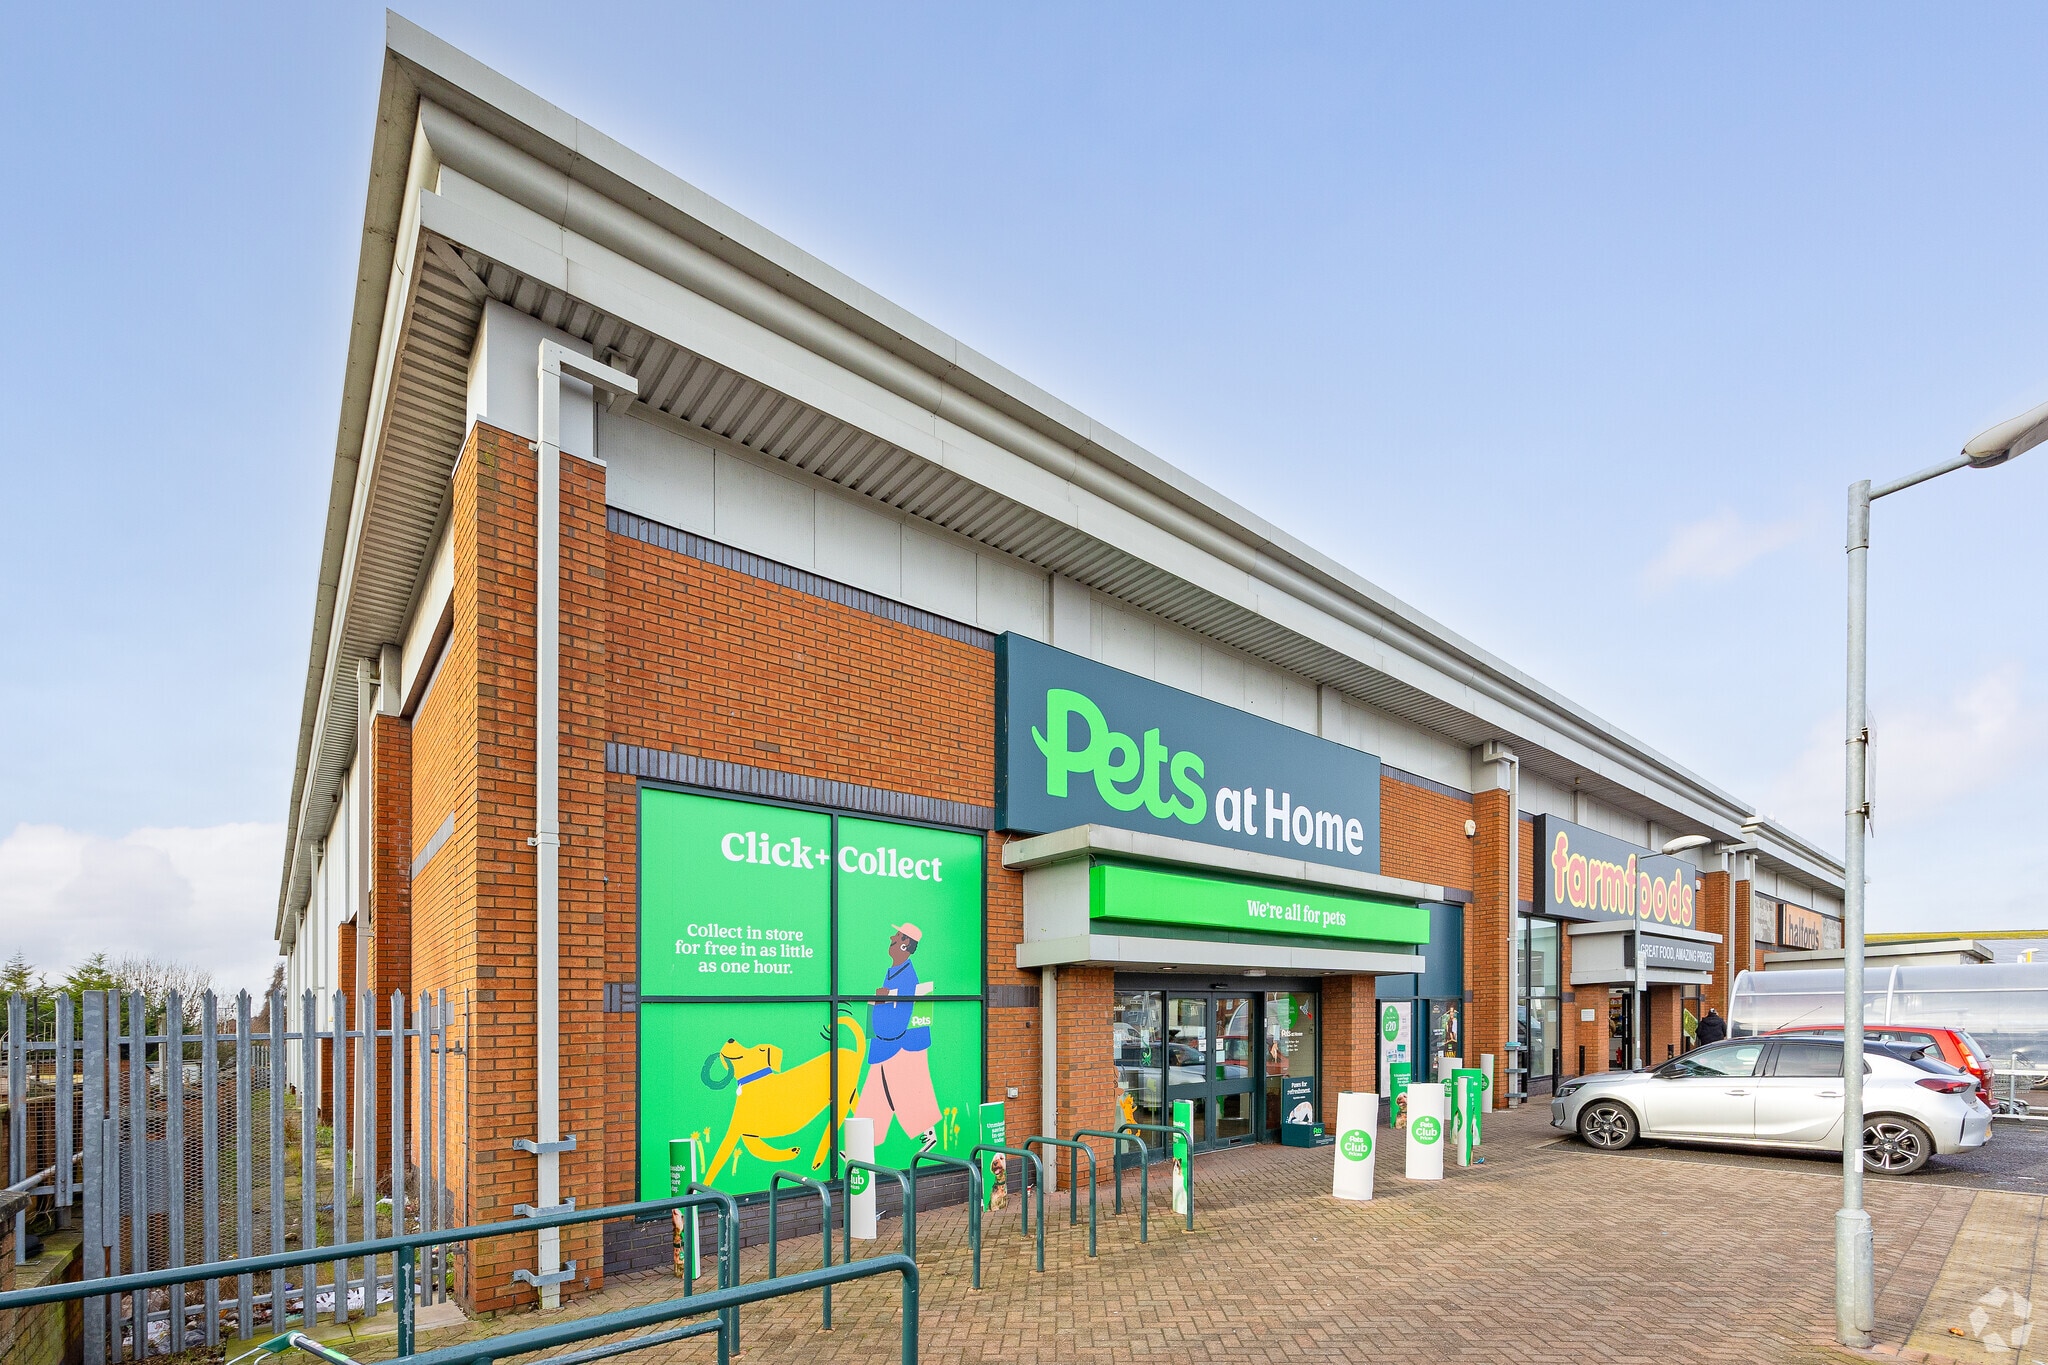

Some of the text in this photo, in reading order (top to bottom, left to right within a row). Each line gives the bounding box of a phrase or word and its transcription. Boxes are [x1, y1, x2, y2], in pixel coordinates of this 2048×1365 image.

[1031, 688, 1364, 857] Pets at Home
[838, 845, 942, 882] Collect
[1551, 831, 1693, 927] farmfoods
[1247, 899, 1346, 928] We're all for pets
[687, 923, 804, 942] Collect in store
[1788, 914, 1819, 950] halfords
[675, 940, 814, 959] for free in as little
[1640, 943, 1659, 958] GREAT
[1675, 948, 1697, 963] AMAZING
[1697, 951, 1712, 964] PRICES
[698, 960, 794, 975] as one hour.
[912, 1016, 931, 1026] Pets
[1415, 1128, 1438, 1136] Club
[1344, 1143, 1368, 1152] Club
[851, 1174, 865, 1185] lub
